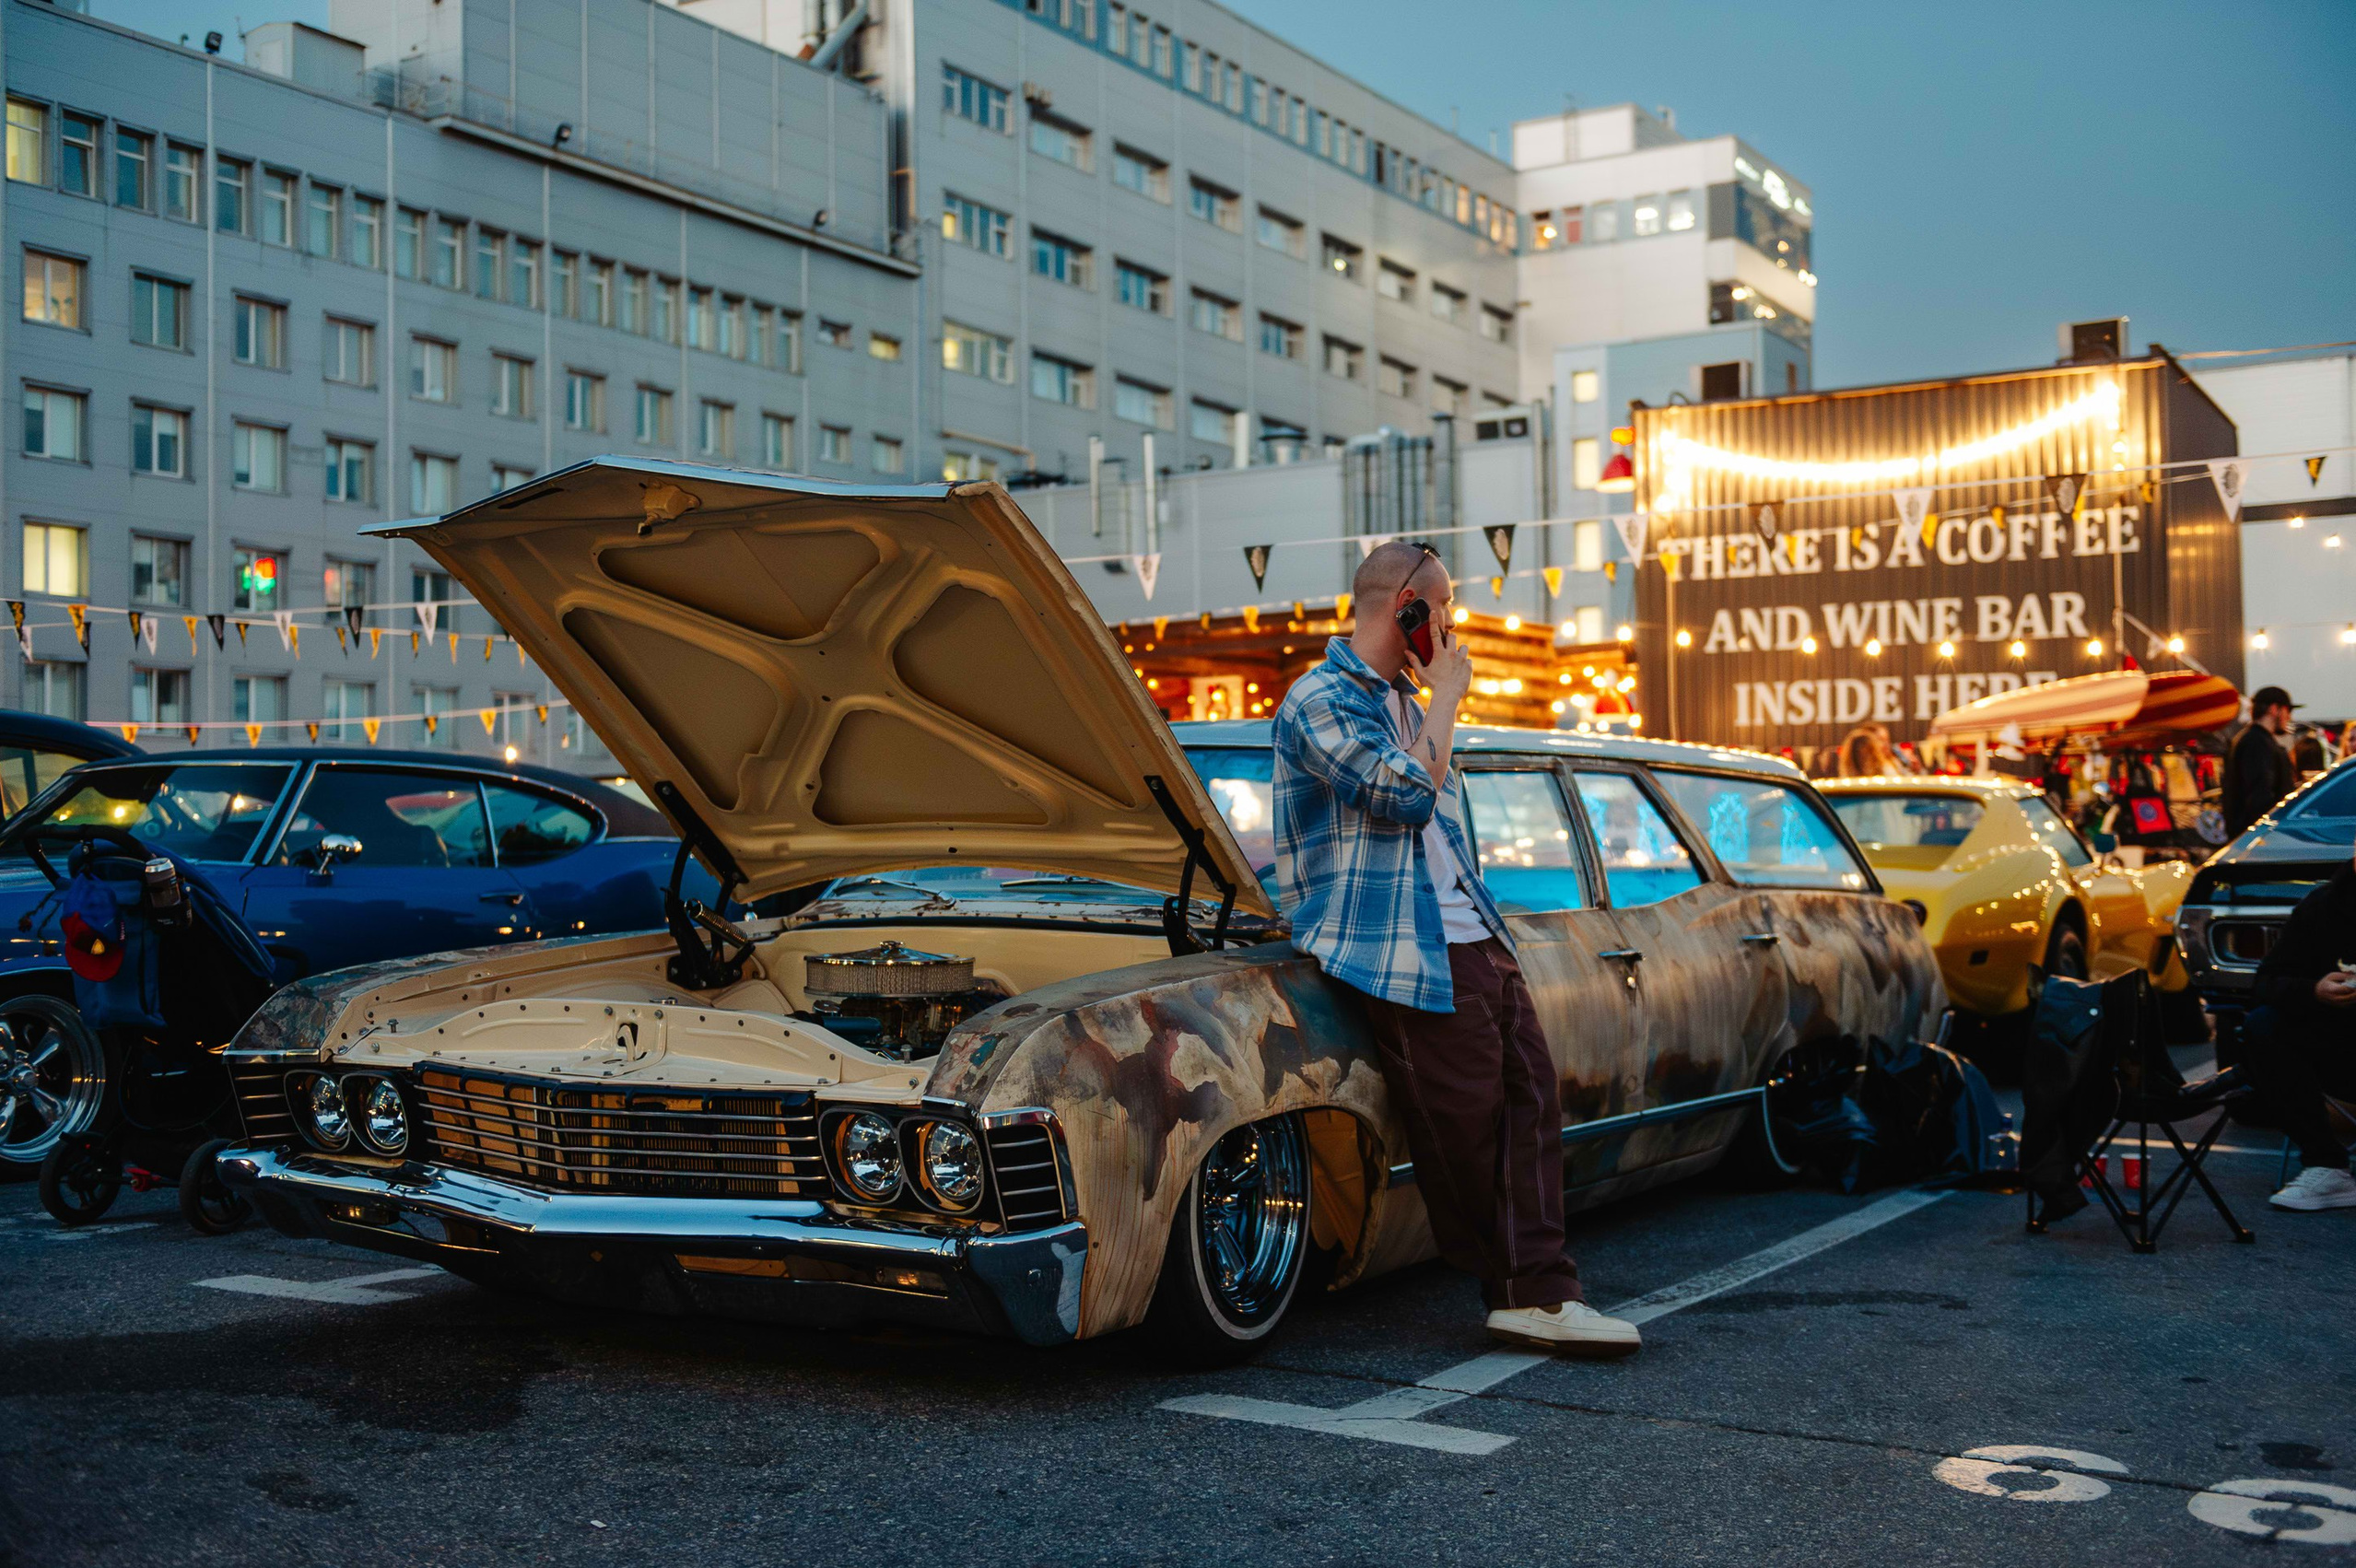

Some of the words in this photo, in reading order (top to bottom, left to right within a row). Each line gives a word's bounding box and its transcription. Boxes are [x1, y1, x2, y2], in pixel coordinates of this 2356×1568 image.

[1658, 527, 1823, 582] THERE
[1834, 521, 1880, 572] IS
[1884, 519, 1926, 568] A
[1935, 505, 2141, 566] COFFEE
[1705, 605, 1812, 654] AND
[1822, 597, 1963, 649] WINE
[1975, 591, 2090, 642] BAR
[1733, 676, 1904, 728] INSIDE
